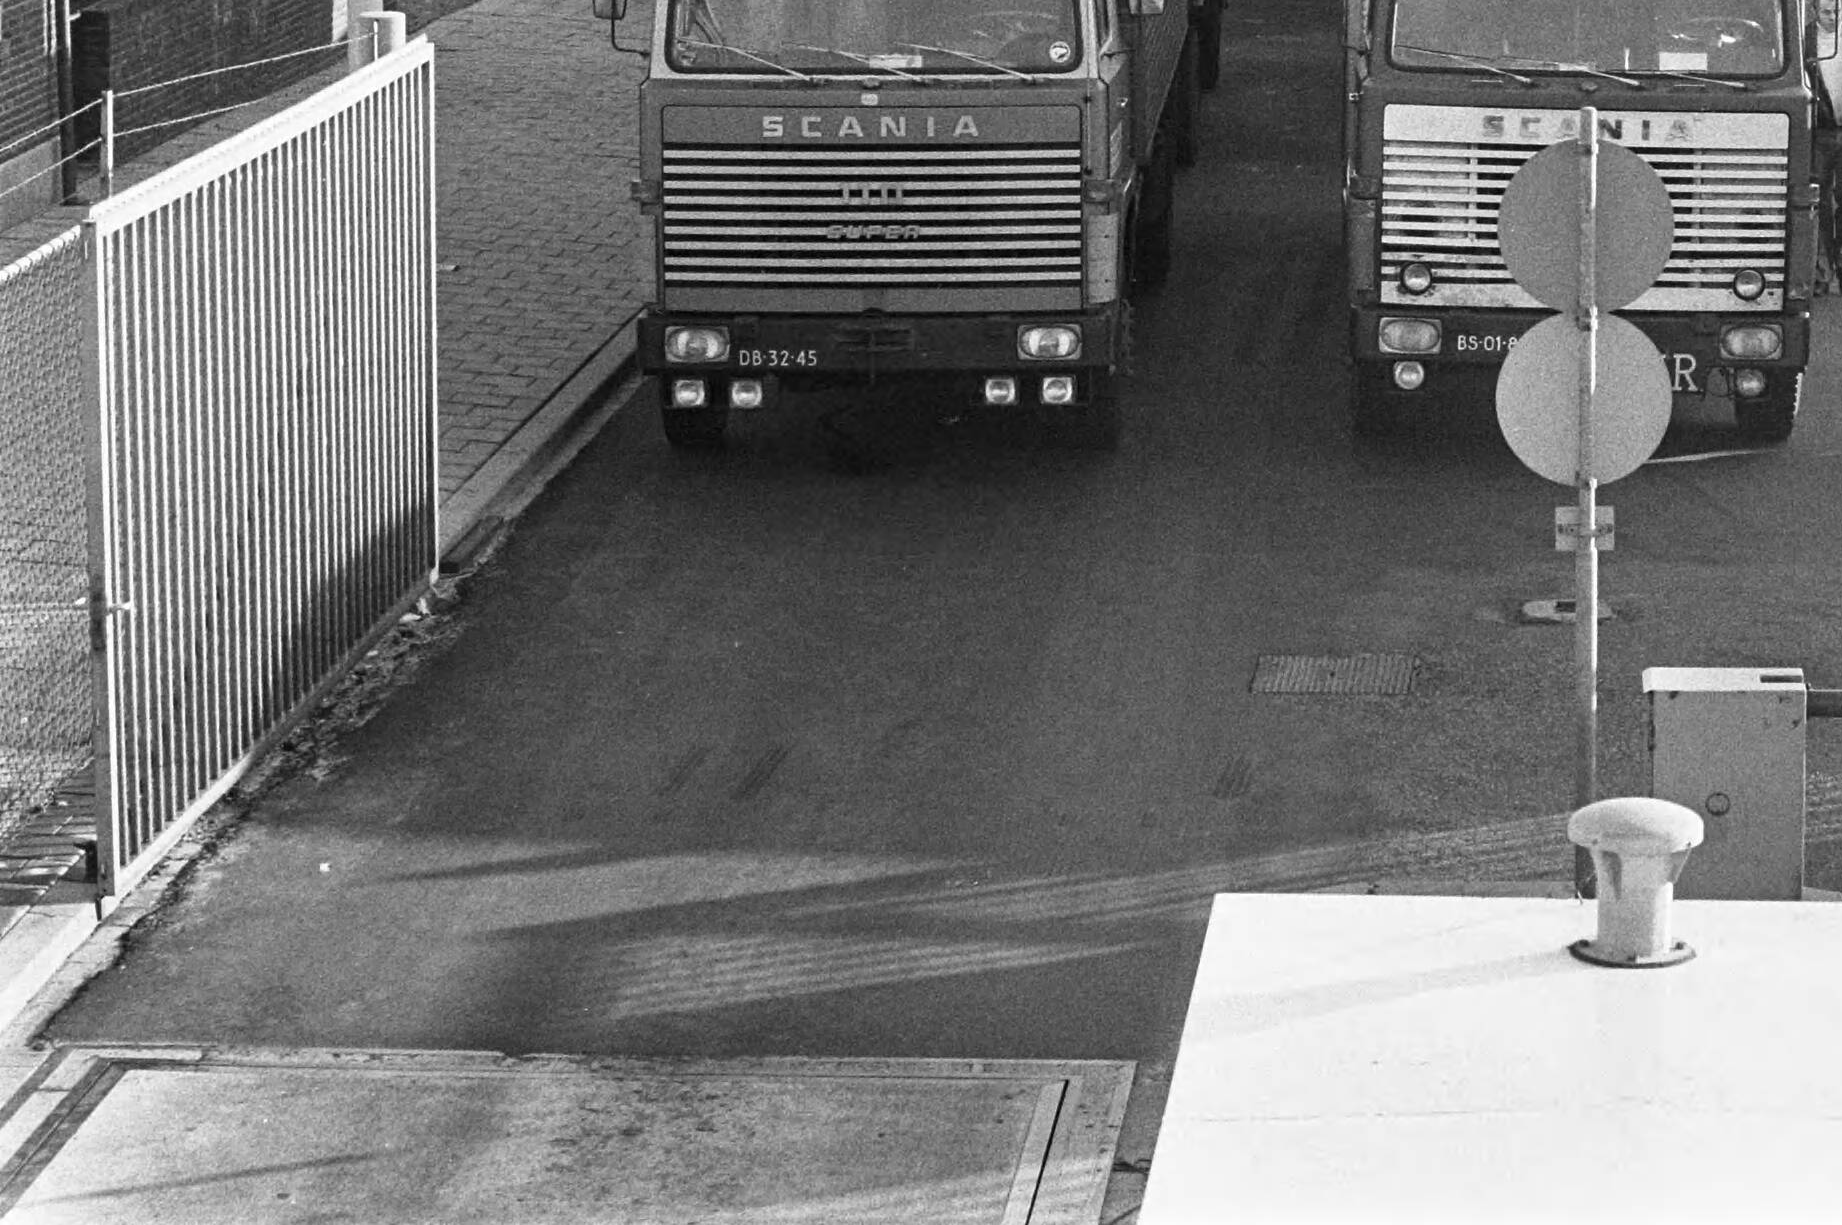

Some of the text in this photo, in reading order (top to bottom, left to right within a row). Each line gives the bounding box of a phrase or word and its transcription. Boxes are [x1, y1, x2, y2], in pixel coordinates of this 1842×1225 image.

[762, 115, 979, 138] SCANIA
[1483, 115, 1692, 141] SCANIA
[826, 224, 921, 240] SUPER
[1457, 334, 1519, 351] BS-01-8
[739, 349, 817, 367] DB-32-45
